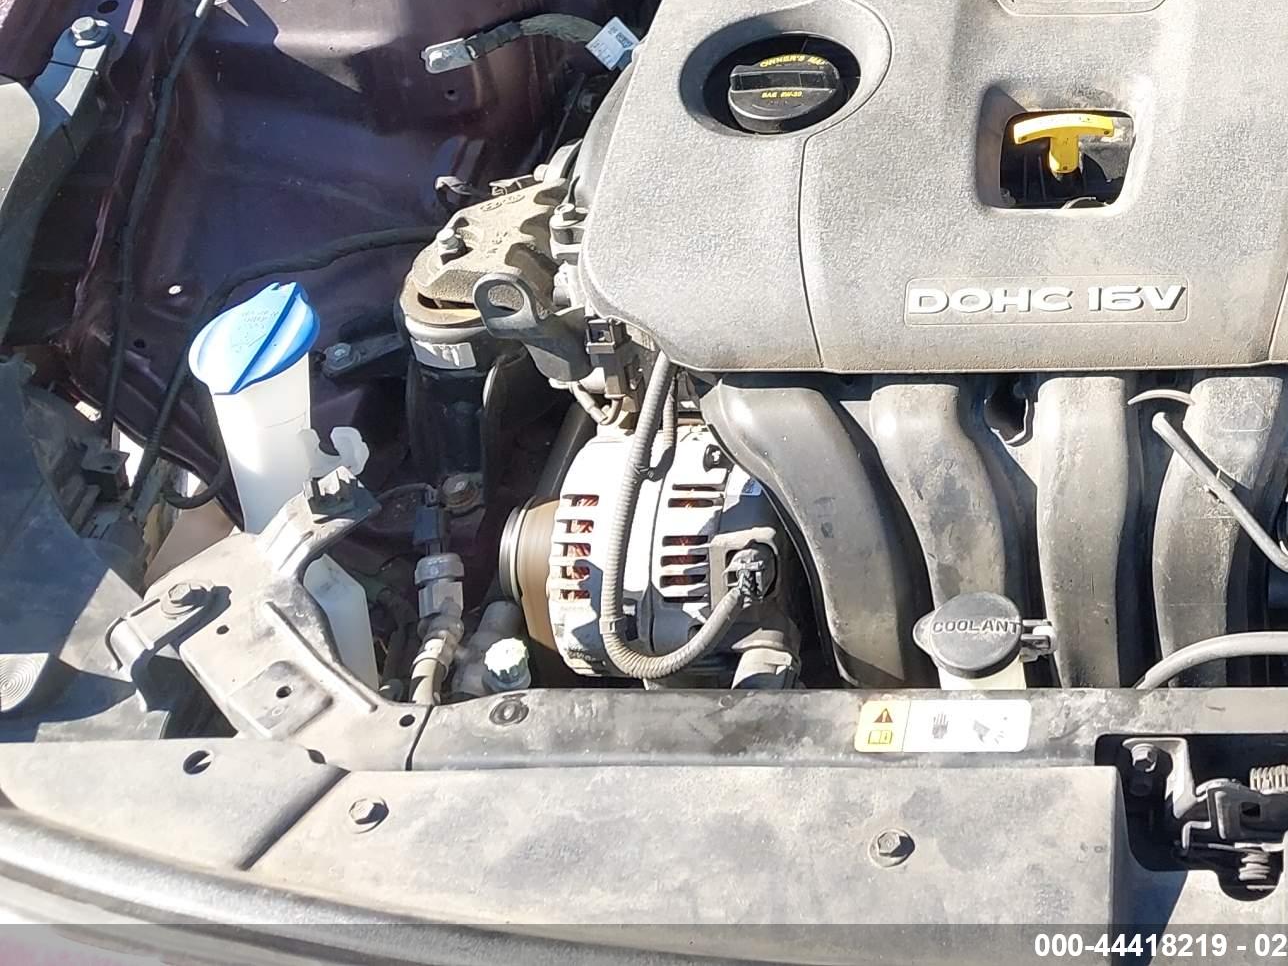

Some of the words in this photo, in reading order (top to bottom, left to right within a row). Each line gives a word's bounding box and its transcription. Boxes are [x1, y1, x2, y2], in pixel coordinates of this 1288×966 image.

[909, 286, 1073, 315] DOHC
[1088, 284, 1187, 313] 16V
[932, 619, 1023, 634] COOLANT
